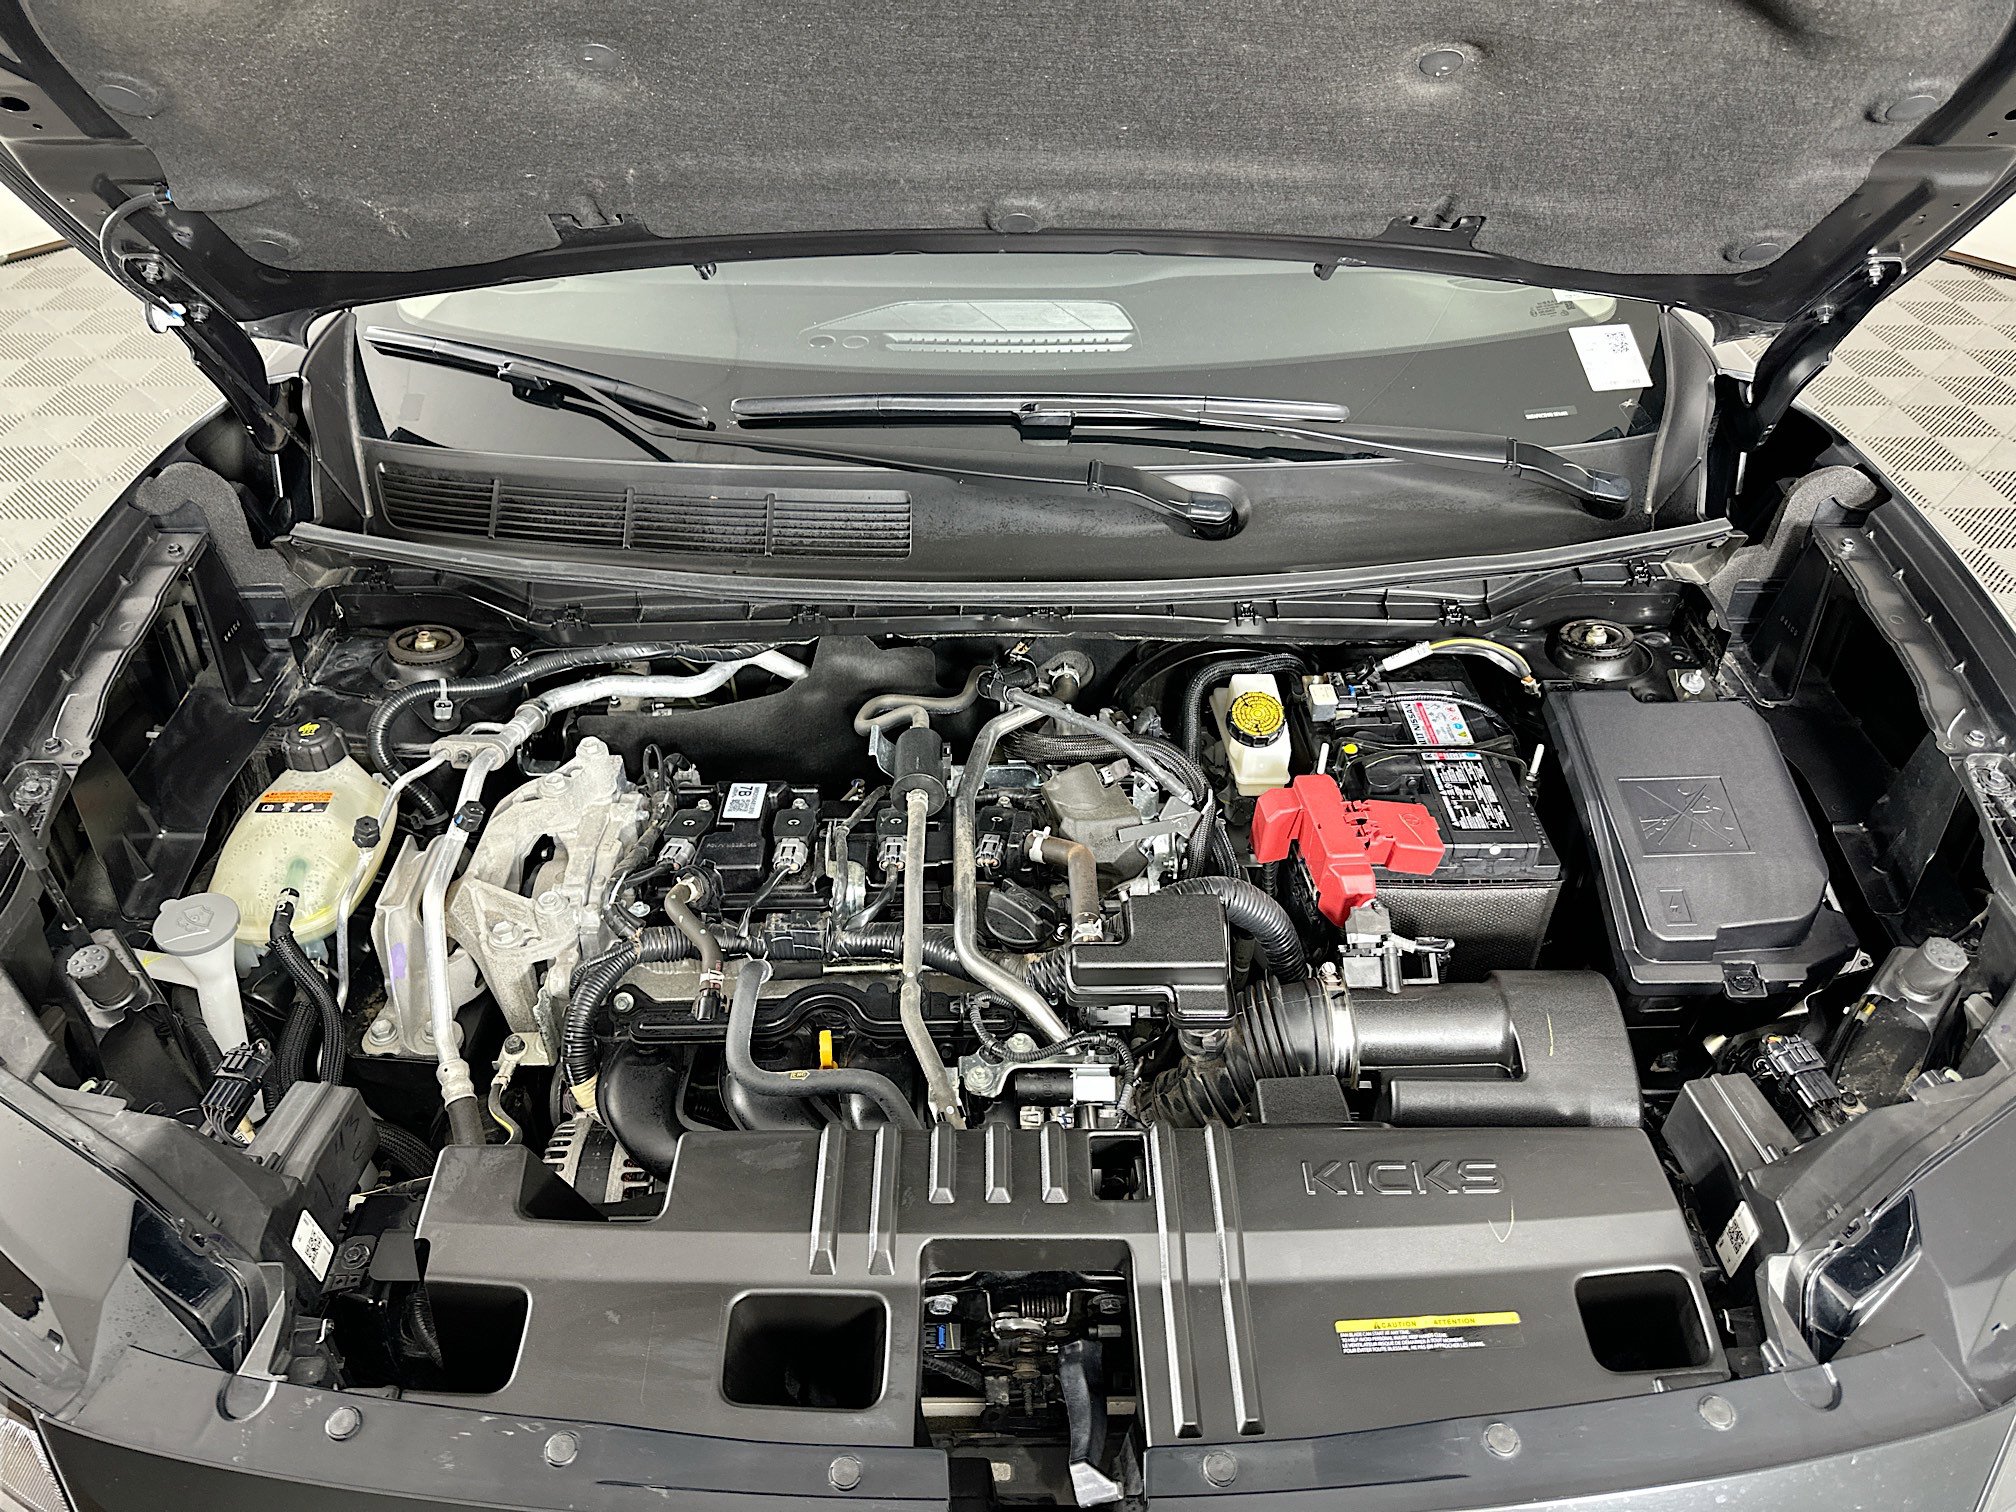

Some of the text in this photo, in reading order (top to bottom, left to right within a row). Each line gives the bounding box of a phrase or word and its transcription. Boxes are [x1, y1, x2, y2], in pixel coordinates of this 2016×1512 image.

[1404, 703, 1421, 731] NISSAN
[738, 786, 753, 797] 7B
[1302, 1160, 1504, 1195] KICKS
[1381, 1317, 1476, 1329] CAUTION ATTENTION
